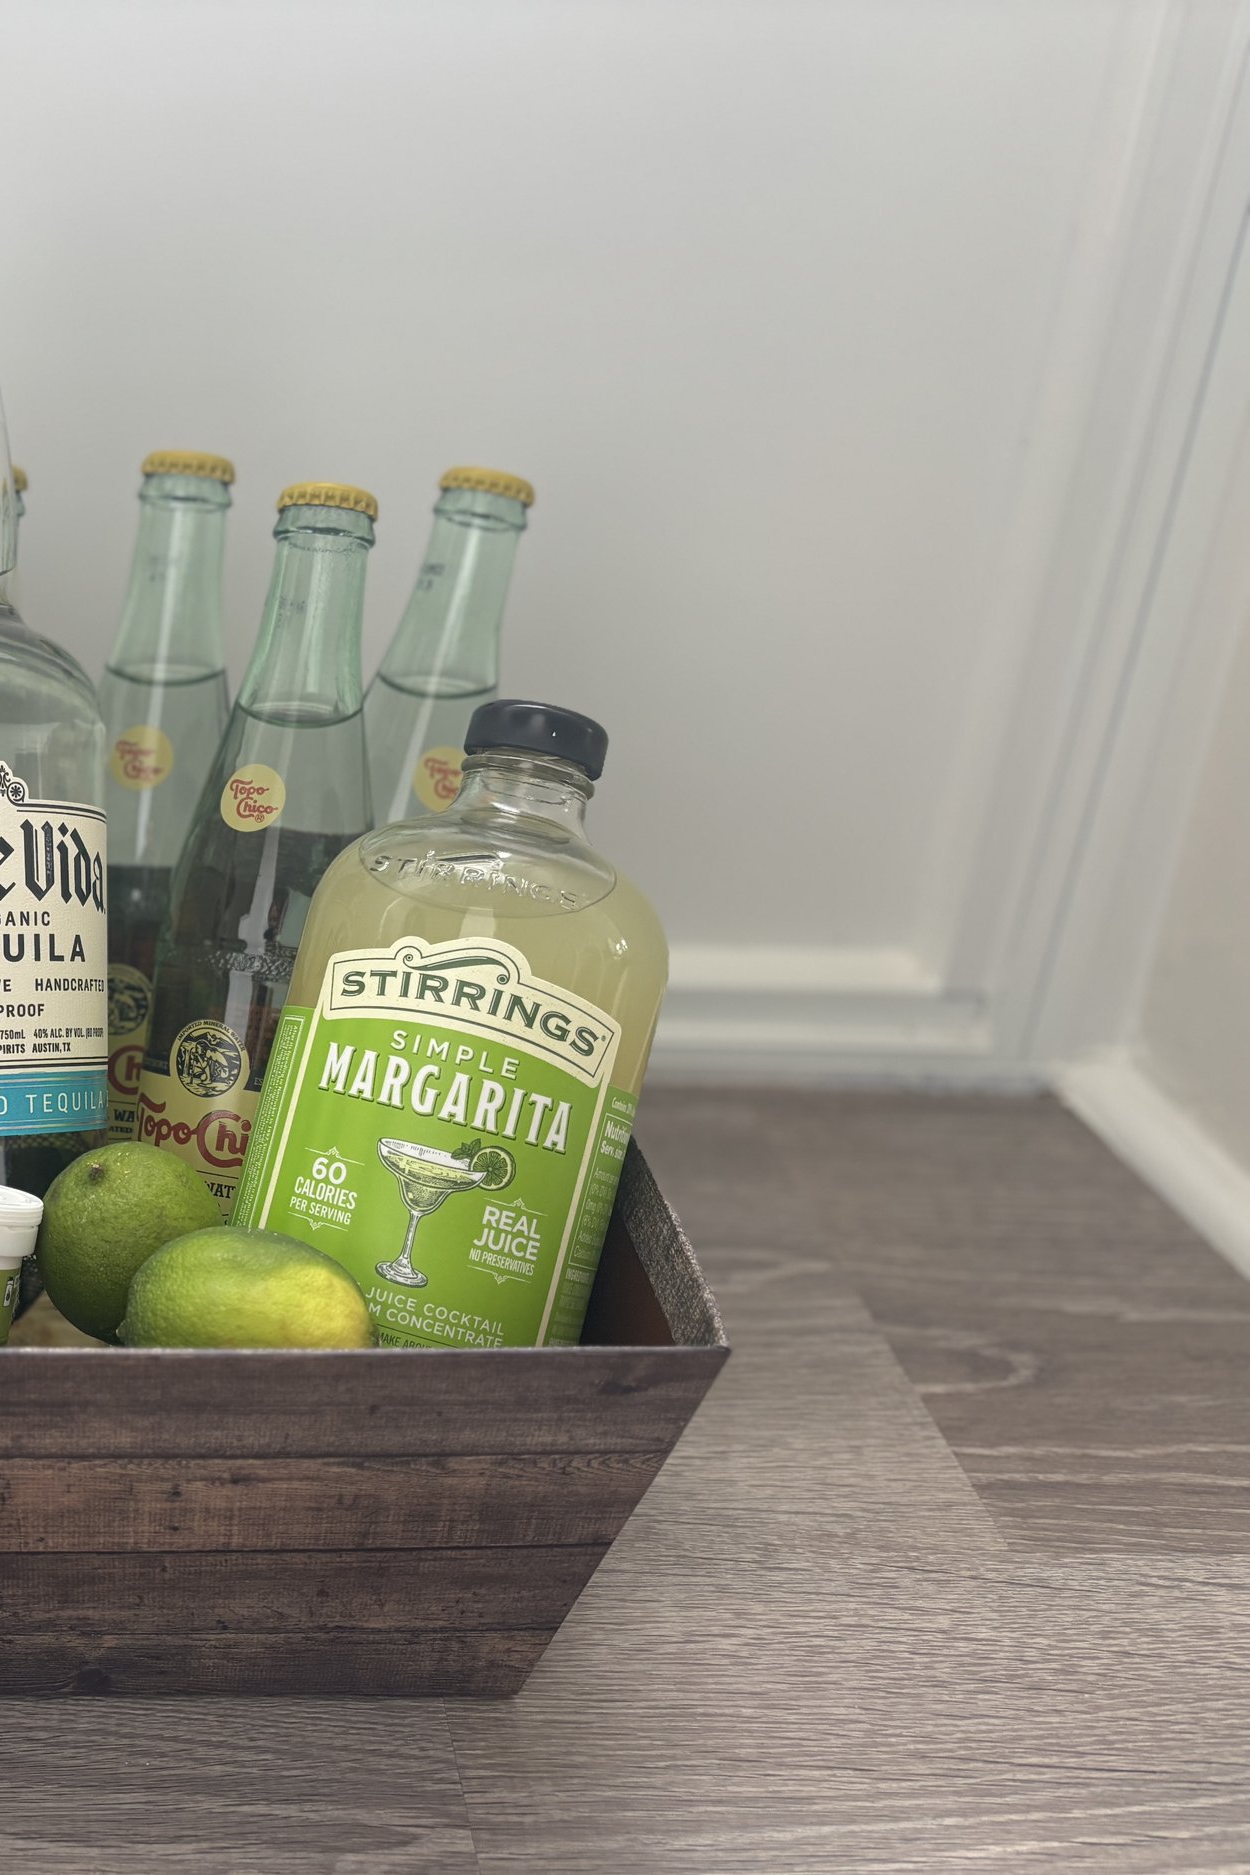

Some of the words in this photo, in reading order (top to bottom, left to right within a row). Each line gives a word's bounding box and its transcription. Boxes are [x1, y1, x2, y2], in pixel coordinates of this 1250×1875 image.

[230, 779, 270, 798] Topo
[236, 797, 279, 819] Chico
[369, 853, 586, 910] STIRRINGS
[35, 977, 104, 993] HANDCRAFTED
[341, 969, 599, 1057] STIRRINGS
[0, 1029, 26, 1040] 750mL
[33, 1028, 49, 1038] 40%
[50, 1028, 64, 1038] ALC.
[65, 1028, 73, 1038] BY
[74, 1028, 85, 1038] VOL.
[390, 1030, 521, 1080] SIMPLE
[25, 1090, 103, 1114] TEQUILA
[318, 1041, 574, 1154] MARGARITA
[137, 1093, 192, 1147] Topo
[196, 1110, 252, 1168] Chi
[312, 1157, 347, 1185] 60
[294, 1176, 358, 1210] CALORIES
[290, 1196, 307, 1212] PER
[309, 1202, 352, 1225] SERVING
[482, 1205, 541, 1240] REAL
[473, 1228, 541, 1261] JUICE
[469, 1247, 481, 1262] NO
[481, 1251, 535, 1276] PRESERVATIVES
[365, 1286, 418, 1312] JUICE
[423, 1303, 505, 1336] COCKTAIL
[386, 1308, 504, 1348] CONCENTRATE
